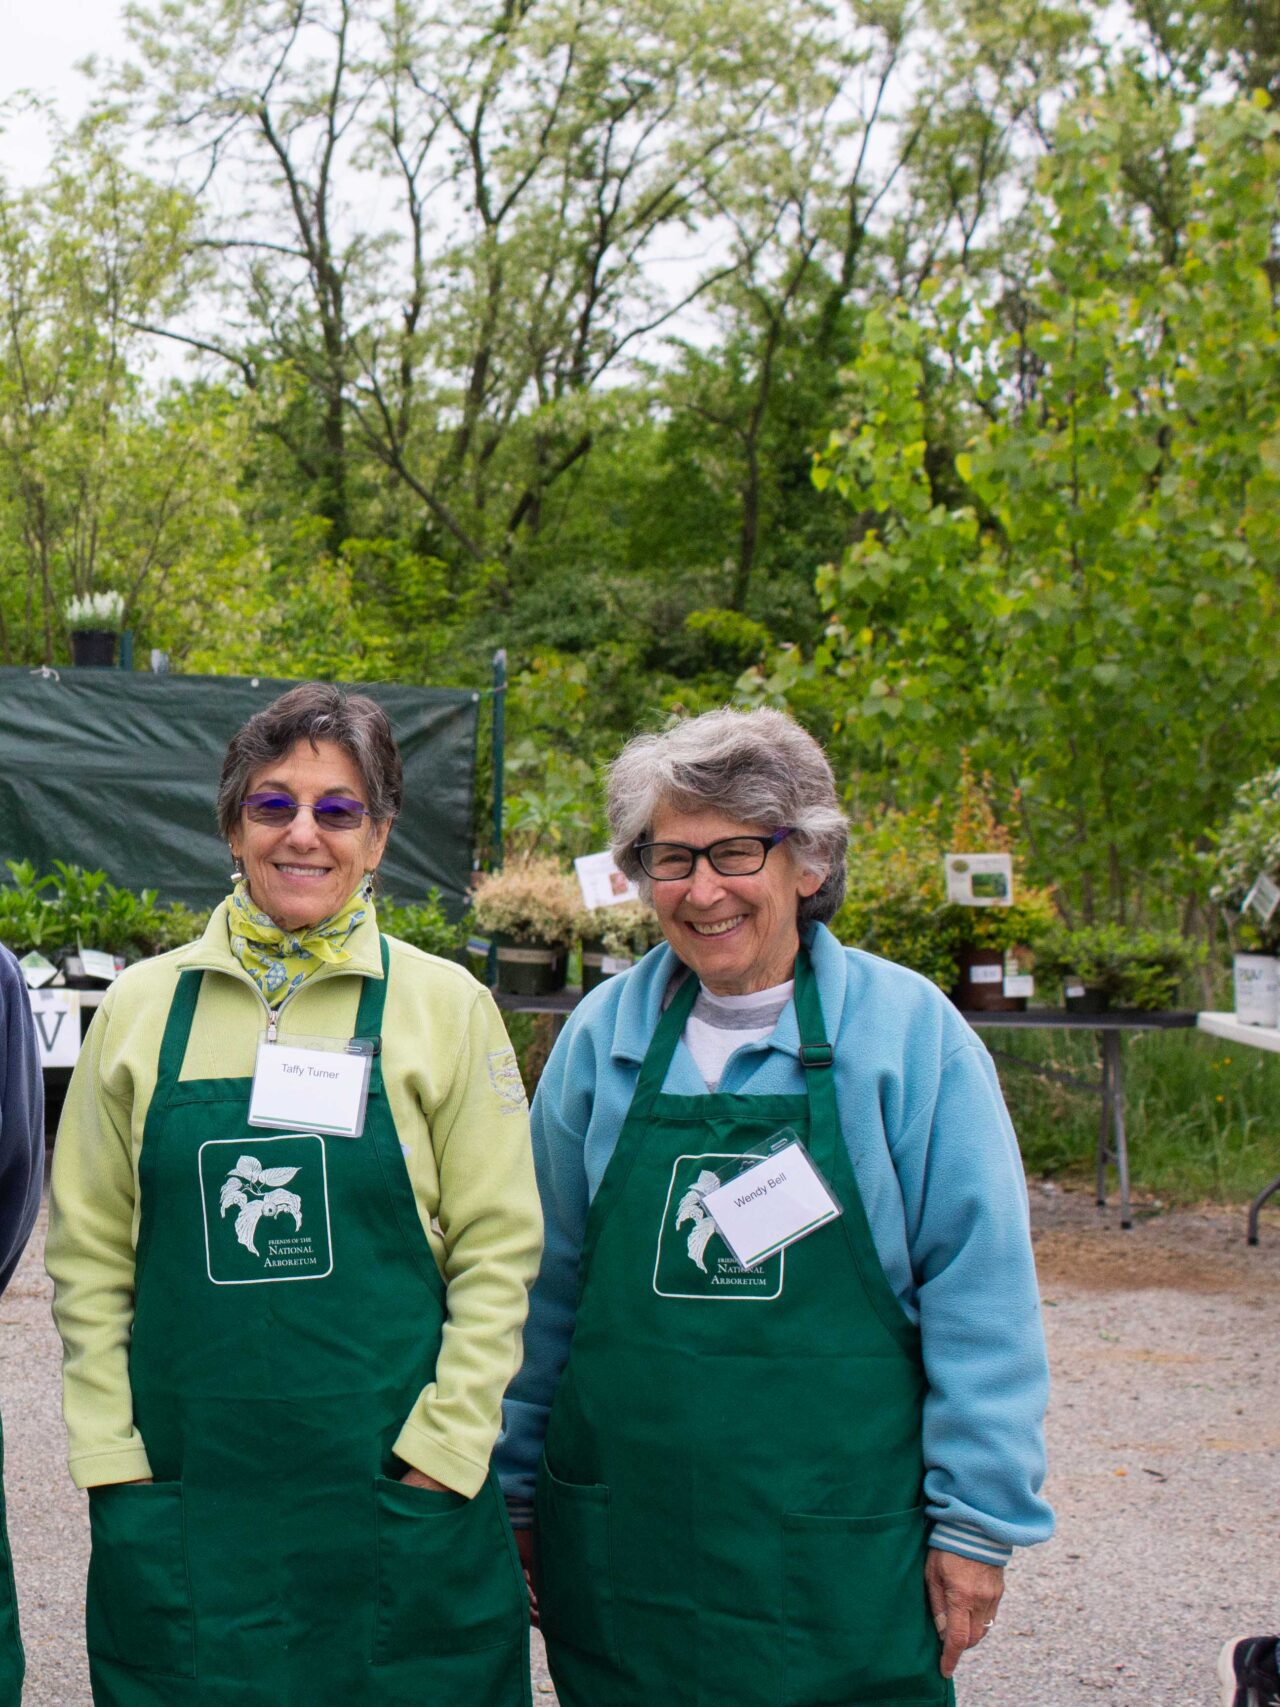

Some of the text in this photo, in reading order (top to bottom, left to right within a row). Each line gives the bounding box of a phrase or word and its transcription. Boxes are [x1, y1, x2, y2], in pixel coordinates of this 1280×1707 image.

[281, 1063, 339, 1079] Taffy Turner
[733, 1172, 787, 1208] Wendy Bell
